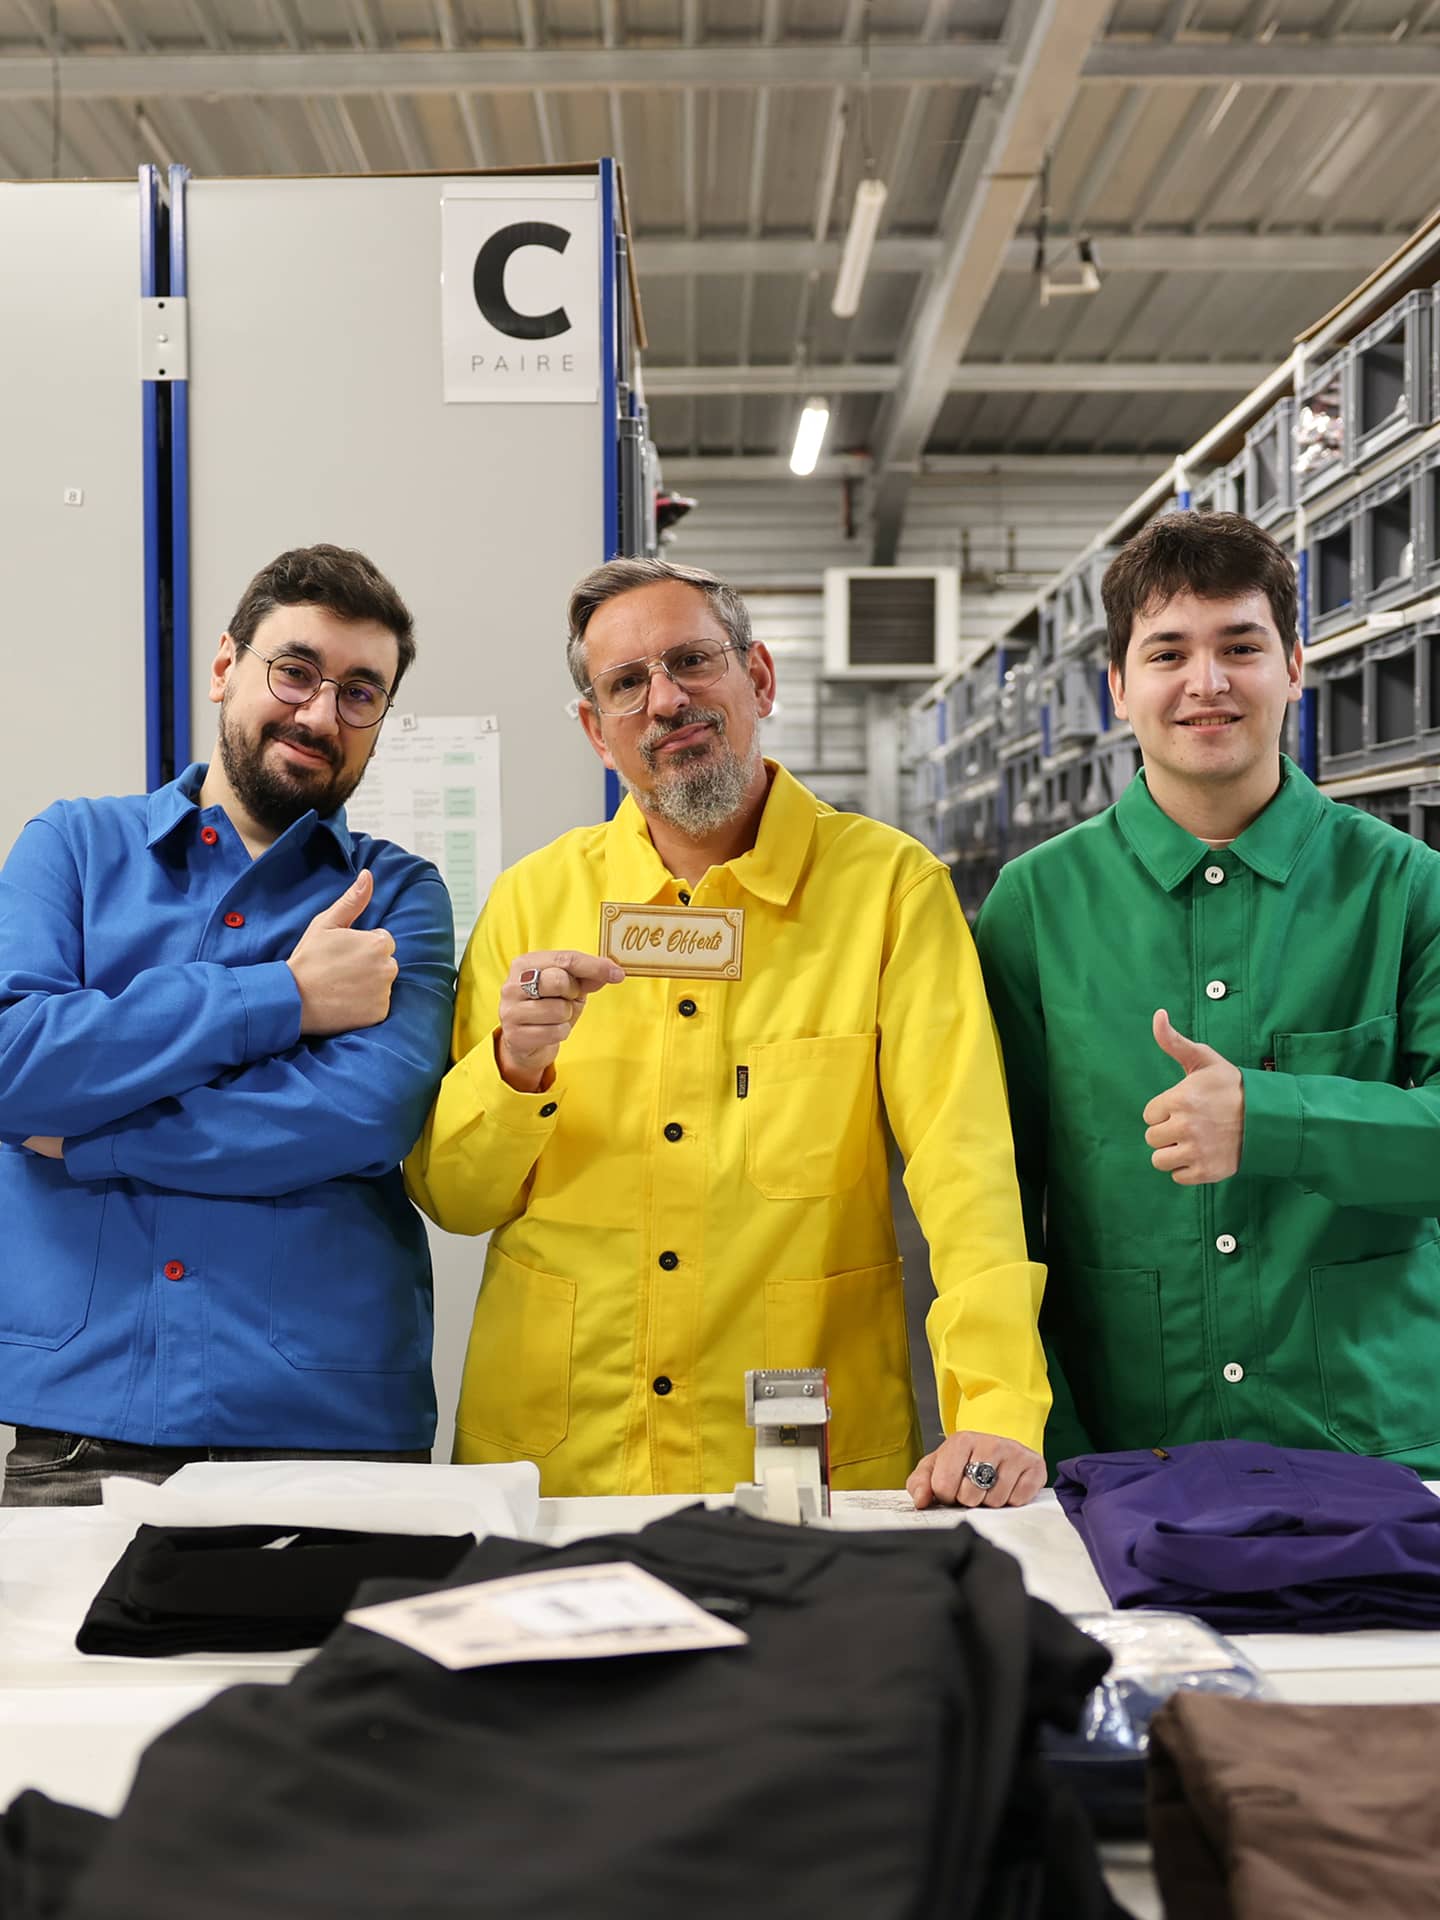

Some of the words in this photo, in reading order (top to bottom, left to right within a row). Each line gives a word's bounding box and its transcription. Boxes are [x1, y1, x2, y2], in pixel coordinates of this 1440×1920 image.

[473, 221, 572, 340] C
[471, 355, 574, 372] PAIRE
[621, 925, 664, 950] 100€
[667, 929, 722, 954] Offerts
